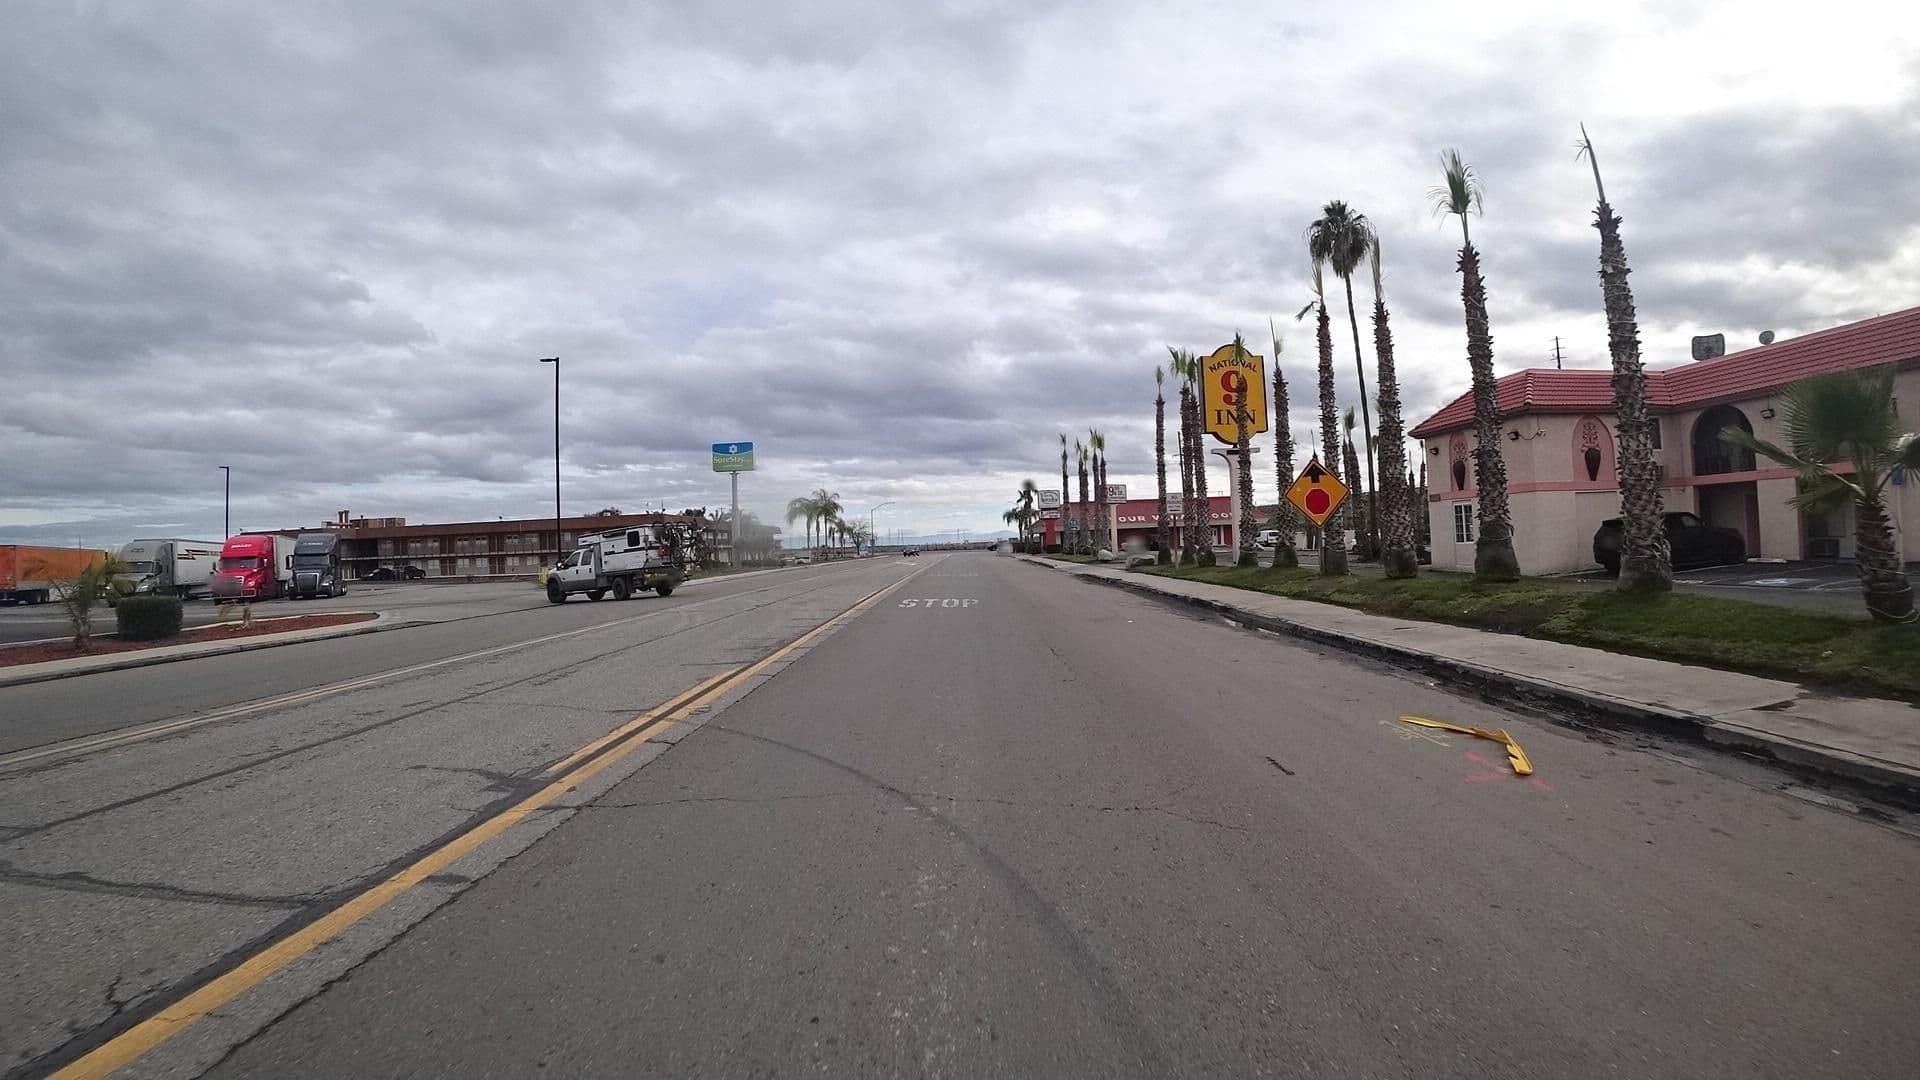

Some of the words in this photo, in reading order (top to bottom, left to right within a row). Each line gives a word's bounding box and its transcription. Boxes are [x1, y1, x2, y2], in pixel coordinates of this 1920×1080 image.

[1208, 359, 1258, 373] NATIONAL
[1221, 370, 1248, 406] 9
[1214, 409, 1257, 425] INN
[898, 598, 979, 608] STOP
